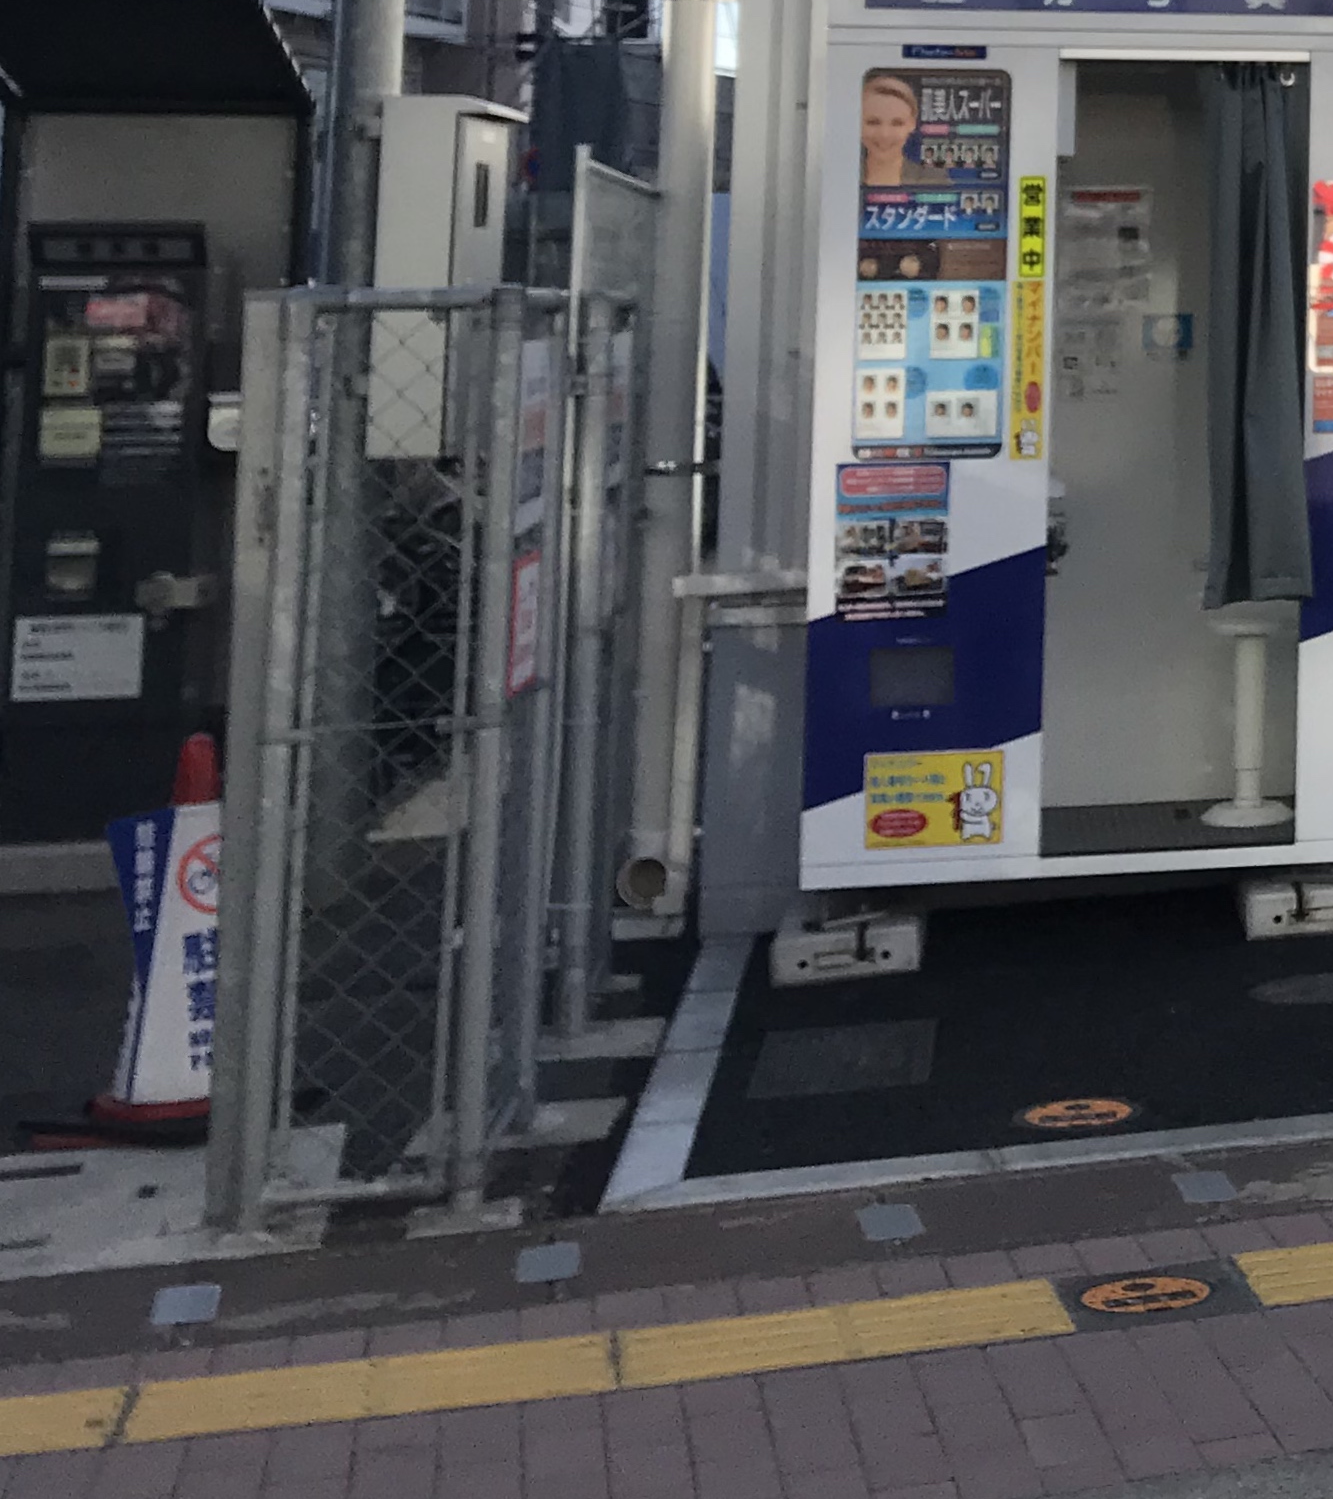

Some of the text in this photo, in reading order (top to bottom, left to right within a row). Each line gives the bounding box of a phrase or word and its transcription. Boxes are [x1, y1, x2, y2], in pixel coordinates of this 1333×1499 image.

[865, 204, 958, 231] スタンダード
